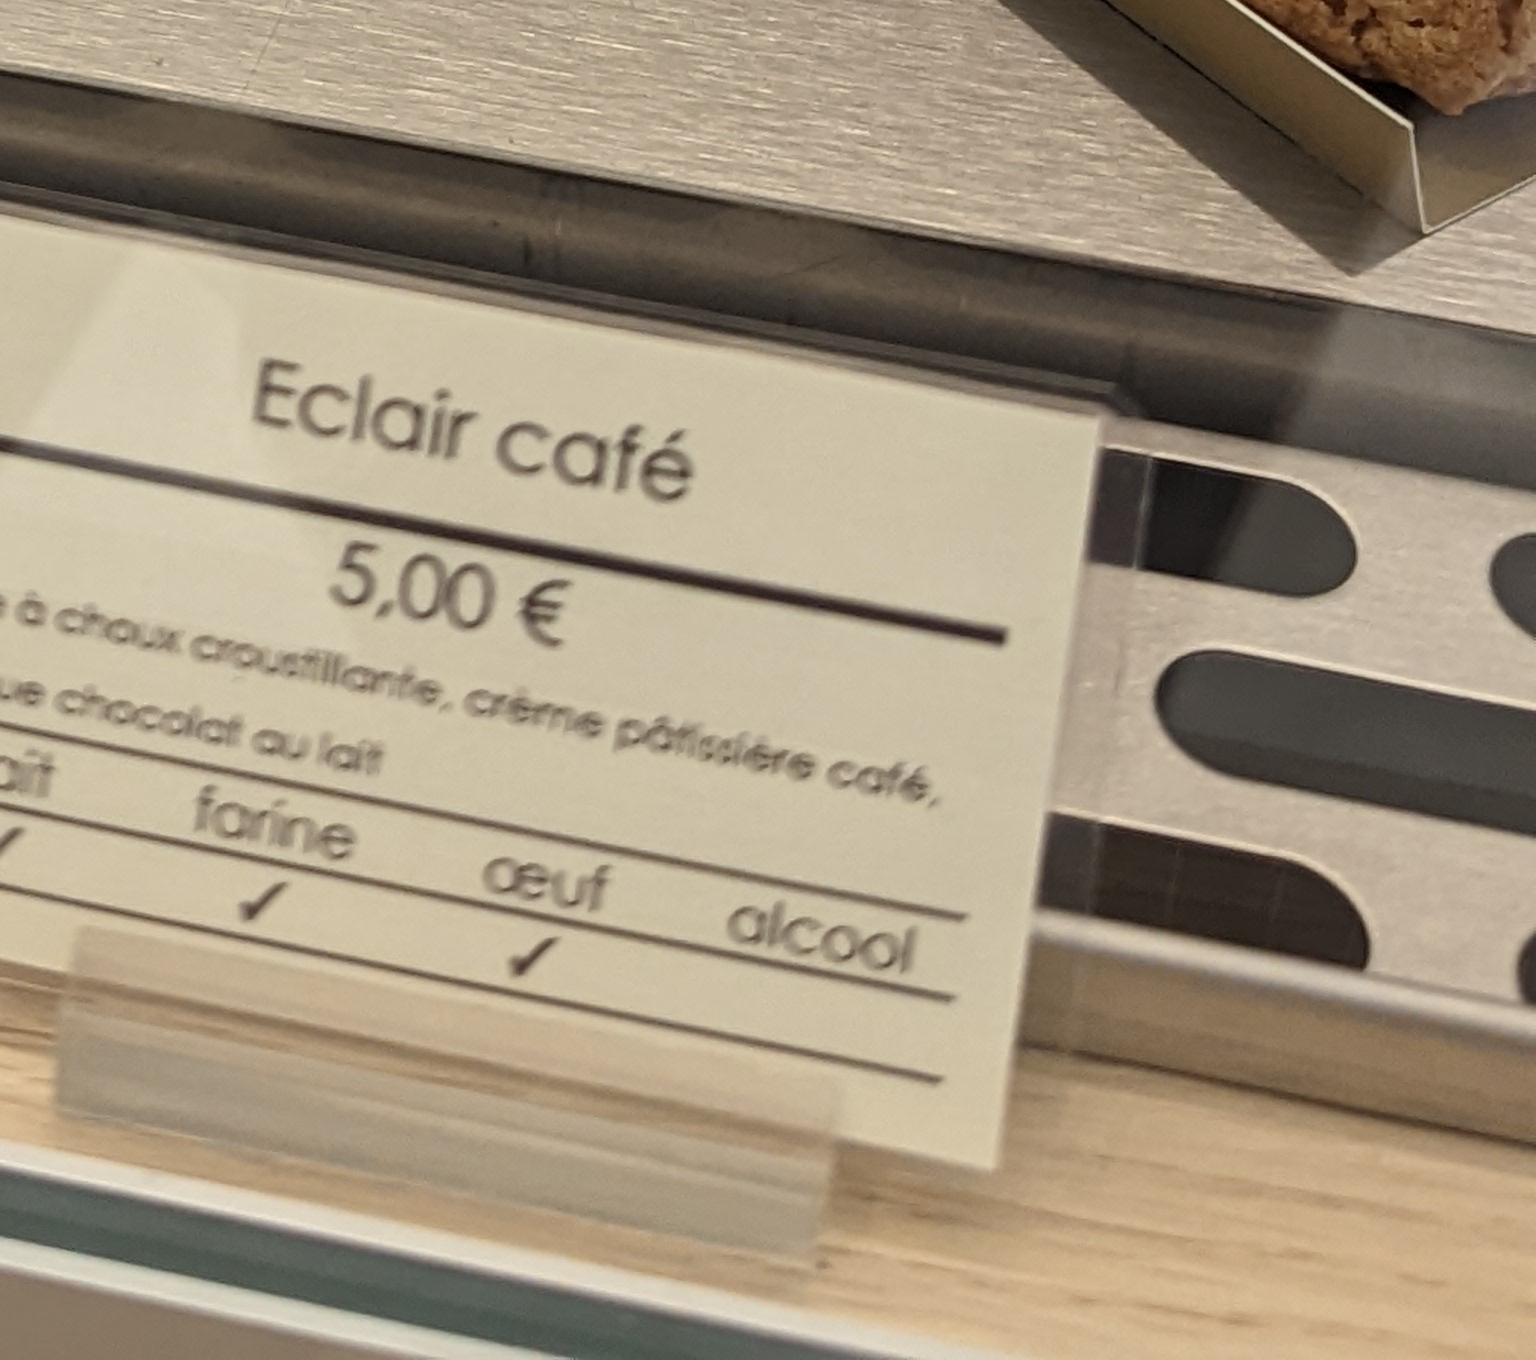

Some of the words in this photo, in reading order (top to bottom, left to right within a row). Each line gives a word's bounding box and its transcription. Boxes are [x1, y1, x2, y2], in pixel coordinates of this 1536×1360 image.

[252, 357, 479, 460] Eclair
[495, 423, 694, 503] café
[328, 540, 496, 631] 5,00
[517, 578, 574, 648] €
[15, 588, 47, 627] à
[53, 603, 185, 653] choux
[189, 633, 453, 713] croustillante,
[463, 686, 605, 738] crème
[613, 715, 816, 781] pâtissière
[826, 761, 942, 809] café,
[53, 685, 245, 746] chocolat
[251, 729, 310, 760] au
[317, 731, 384, 774] lait
[193, 784, 357, 860] farine
[482, 856, 614, 912] œuf
[726, 900, 919, 974] alcool
